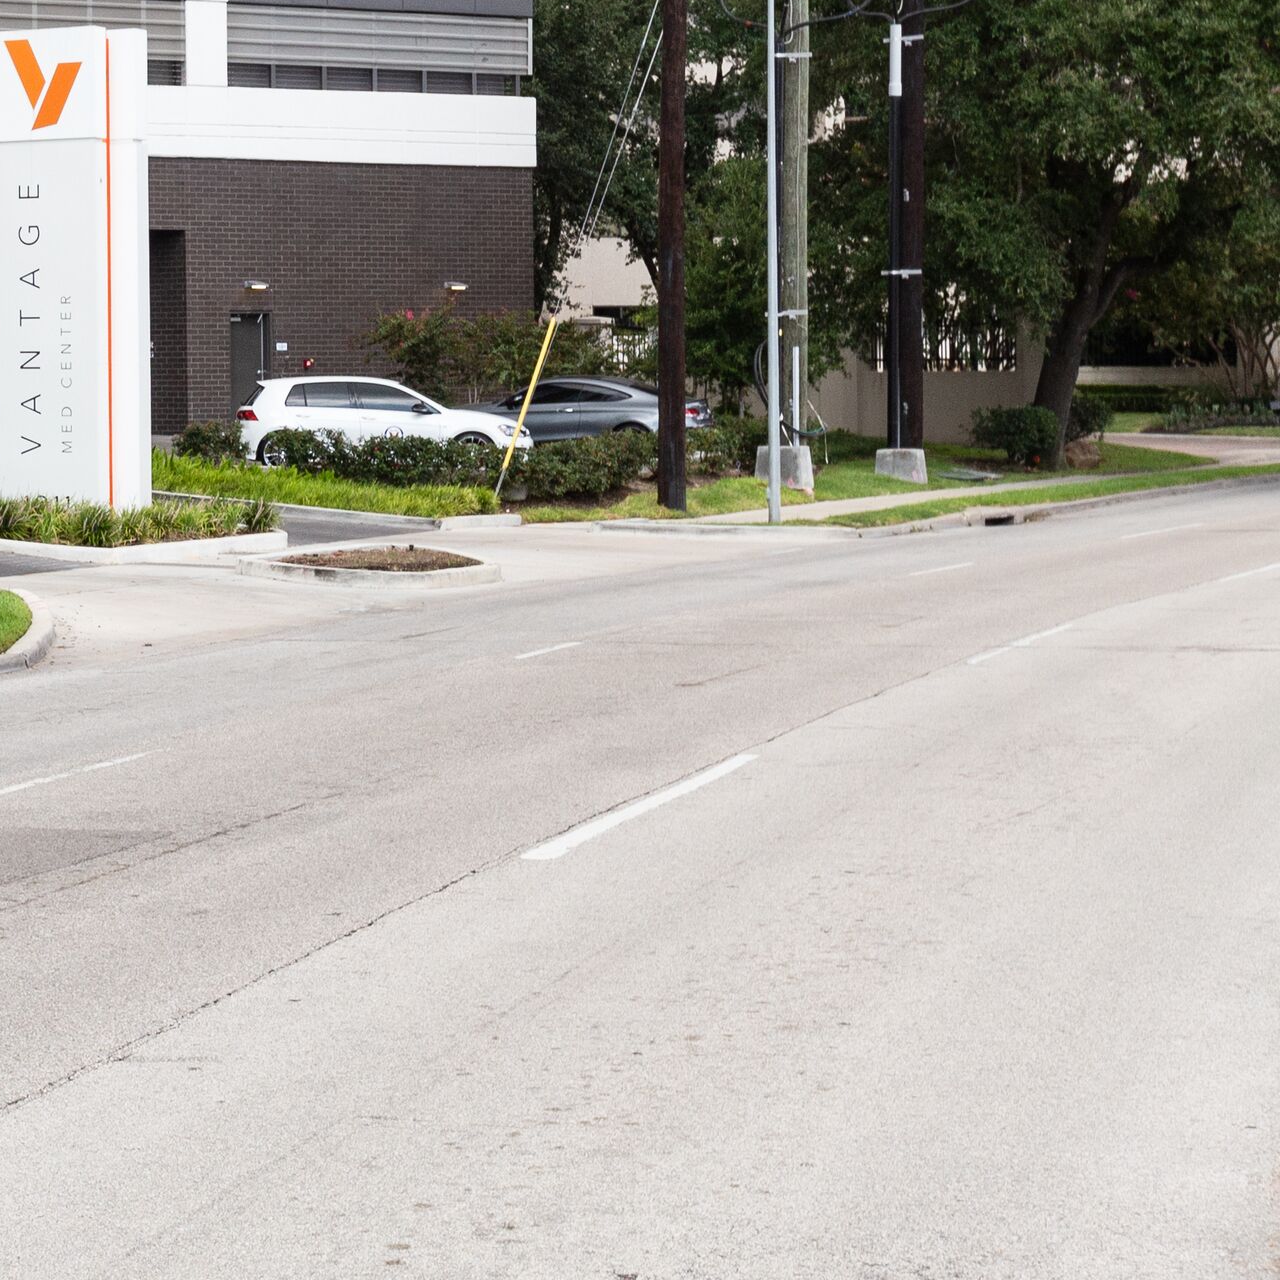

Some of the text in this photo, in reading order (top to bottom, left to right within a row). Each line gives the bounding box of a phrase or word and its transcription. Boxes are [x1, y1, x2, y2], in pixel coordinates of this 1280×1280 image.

[17, 183, 42, 455] VANTAGE
[59, 295, 73, 454] MED CENTER
